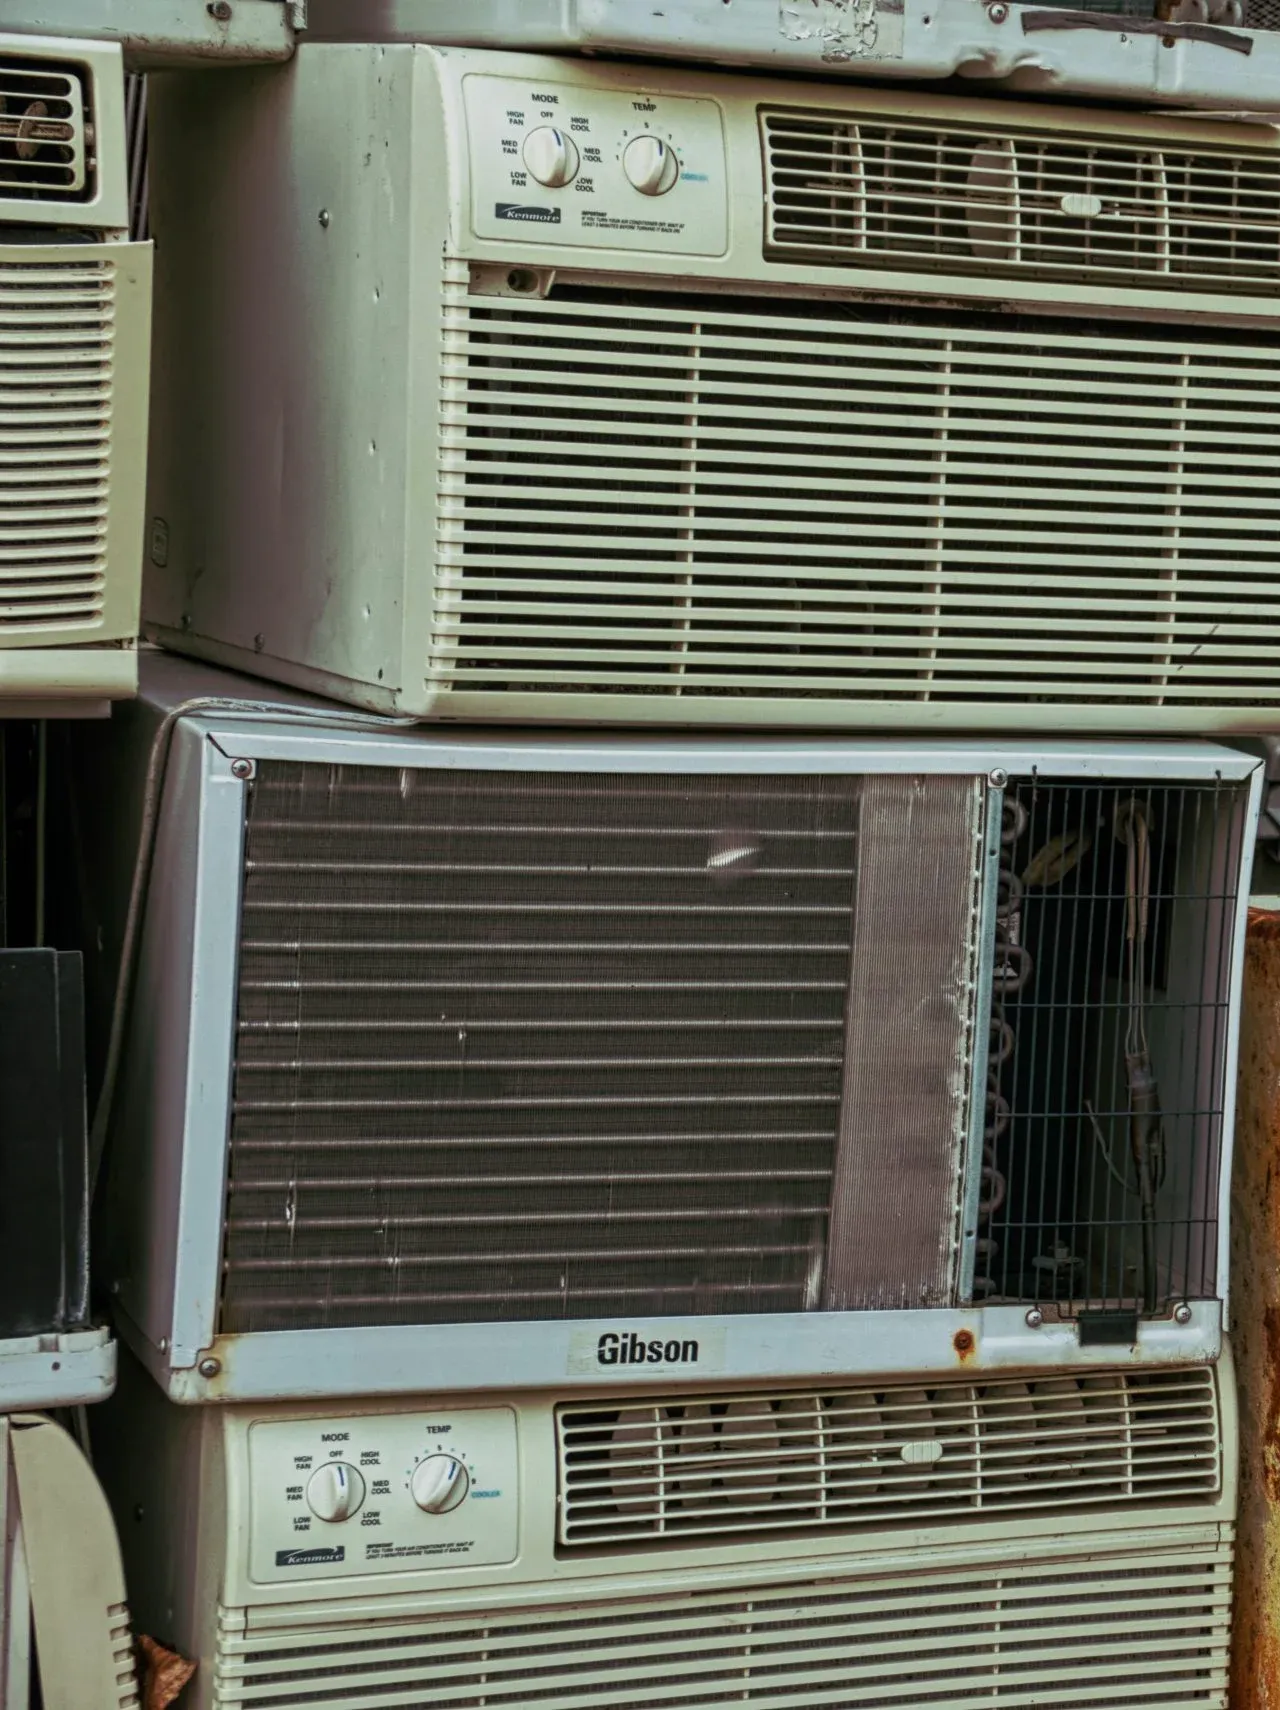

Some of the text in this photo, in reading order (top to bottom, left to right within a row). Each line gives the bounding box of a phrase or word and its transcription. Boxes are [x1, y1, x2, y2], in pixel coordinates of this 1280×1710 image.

[532, 94, 559, 104] MODE
[632, 102, 657, 112] TEMP
[571, 124, 590, 132] COOL
[584, 147, 600, 155] MED
[507, 211, 560, 222] Kenmore
[598, 1333, 699, 1365] Gibson
[426, 1425, 452, 1434] TEMP
[321, 1433, 350, 1442] MODE
[288, 1554, 344, 1564] Kenmore
